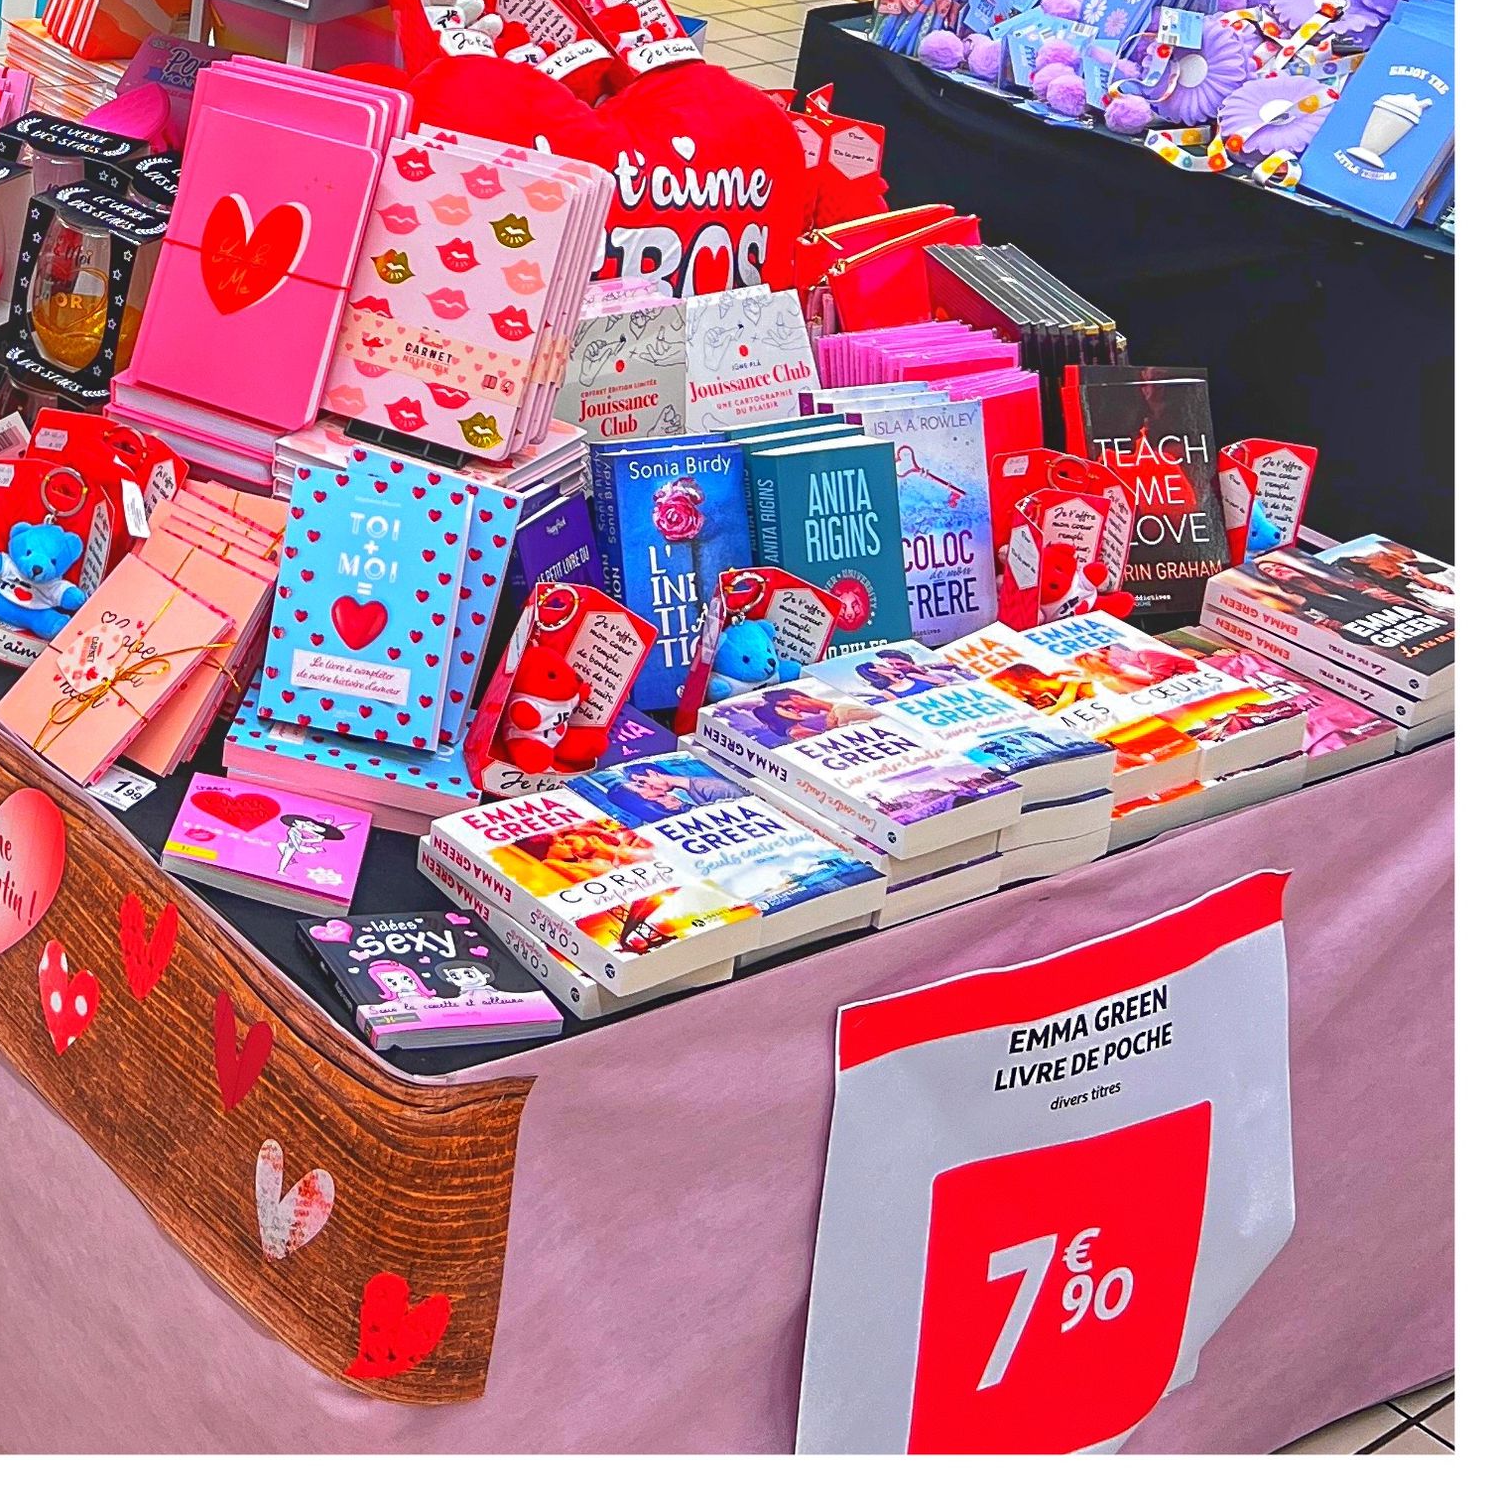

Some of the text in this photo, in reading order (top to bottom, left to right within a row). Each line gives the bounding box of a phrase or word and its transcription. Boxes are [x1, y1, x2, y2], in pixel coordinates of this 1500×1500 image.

[614, 136, 774, 209] t'aime
[402, 354, 451, 374] NOTEBOOK
[405, 342, 453, 364] CARNET
[688, 361, 811, 404] Jouissance Club
[578, 391, 659, 423] Jouissance
[873, 409, 976, 436] ISLA ROWLEY
[600, 416, 638, 438] Club
[1092, 433, 1210, 468] TEACH
[628, 455, 732, 481] Sonia Birdy
[808, 467, 874, 517] ANITA
[1135, 474, 1186, 506] ME
[349, 511, 402, 542] TOI
[761, 523, 780, 564] ANITA
[804, 511, 881, 563] RIGINS
[337, 551, 400, 584] MOI
[1122, 559, 1224, 582] RIN GRAHAM
[594, 614, 609, 628] Je
[1024, 617, 1106, 647] EMMA
[1218, 593, 1299, 638] EMMA GREEN
[1342, 603, 1423, 639] EMMA
[1368, 613, 1450, 649] GREEN
[1048, 625, 1128, 659] GREEN
[309, 656, 324, 669] Le
[324, 660, 346, 672] livre
[296, 668, 402, 697] de notre histoire d'amour
[895, 686, 995, 717] EMMA
[920, 697, 1019, 729] GREEN
[702, 723, 789, 783] EMMA GREEN
[794, 724, 899, 761] EMMA
[821, 735, 924, 771] GREEN
[500, 770, 536, 791] Je
[461, 796, 568, 830] EMMA
[483, 807, 586, 842] GREEN
[655, 804, 769, 842] EMMA
[680, 817, 787, 856] GREEN
[432, 837, 513, 904] EMMA GREEN
[558, 859, 675, 905] CORPS
[372, 917, 419, 933] Idées
[528, 910, 580, 957] CORPS
[356, 929, 458, 959] sexy
[1008, 983, 1169, 1056] EMMA GREEN
[993, 1021, 1174, 1092] LIVRE DE POCHE
[1049, 1081, 1122, 1112] divers titres
